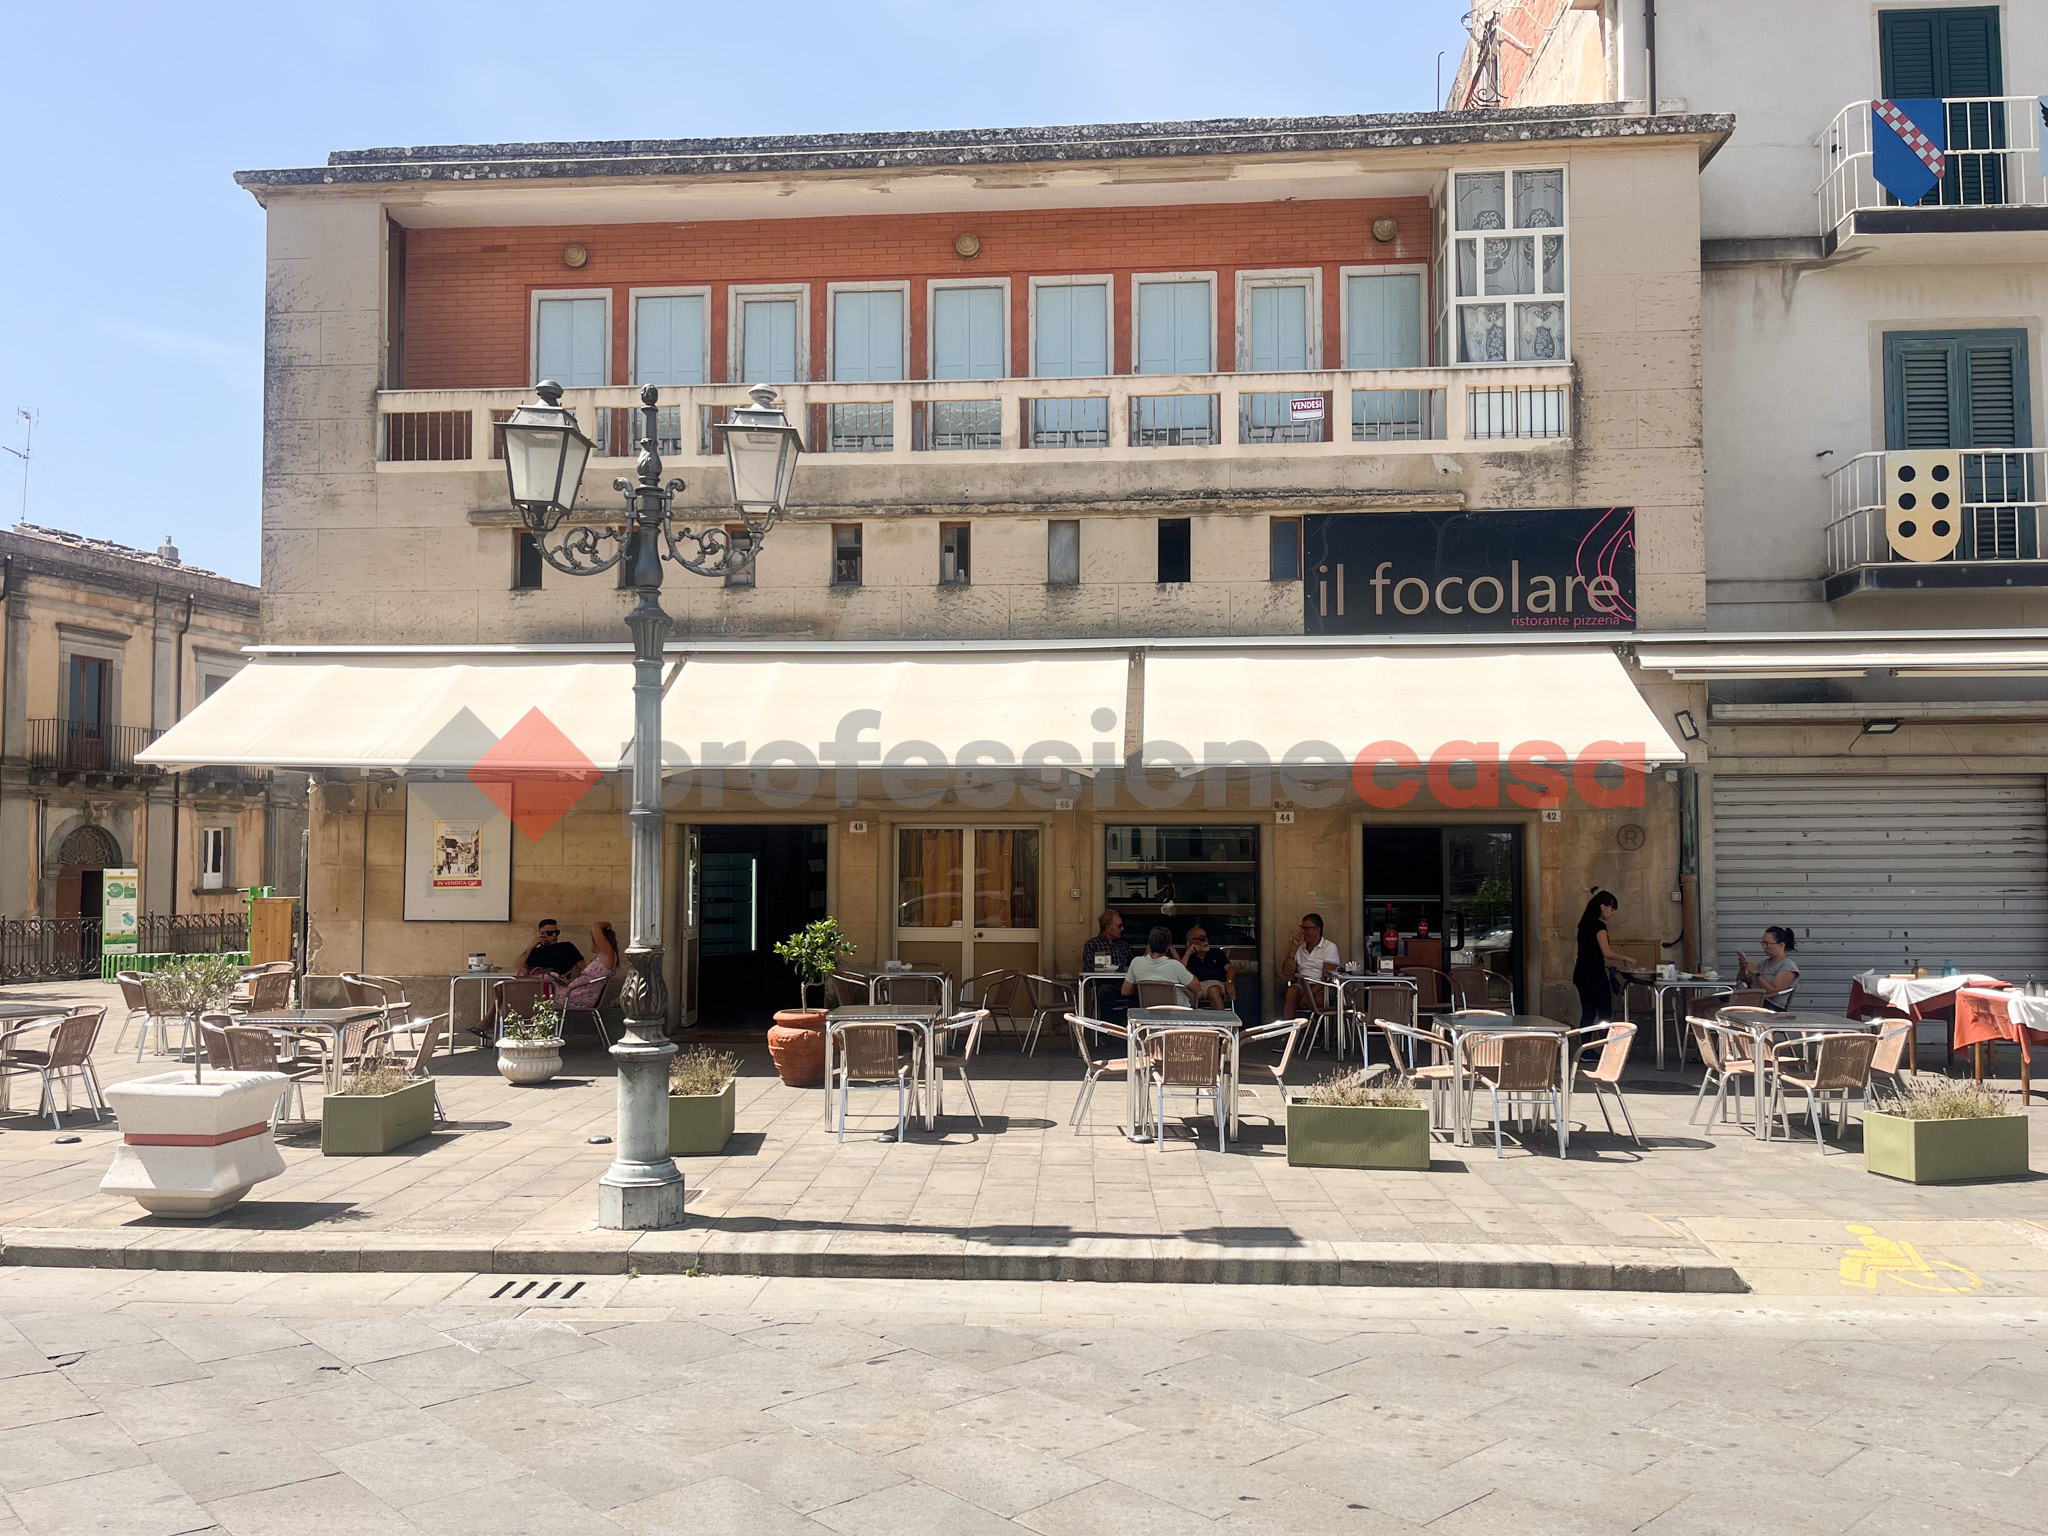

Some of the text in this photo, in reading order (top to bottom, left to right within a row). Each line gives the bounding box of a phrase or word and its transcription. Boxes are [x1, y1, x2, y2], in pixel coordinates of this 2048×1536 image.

[1292, 400, 1321, 410] VENDESI
[1319, 559, 1620, 617] il focolare
[1511, 614, 1620, 629] ristorante pizzeria
[1060, 800, 1070, 808] 46
[1279, 813, 1290, 822] 44
[1545, 812, 1557, 820] 42
[853, 823, 864, 831] 48
